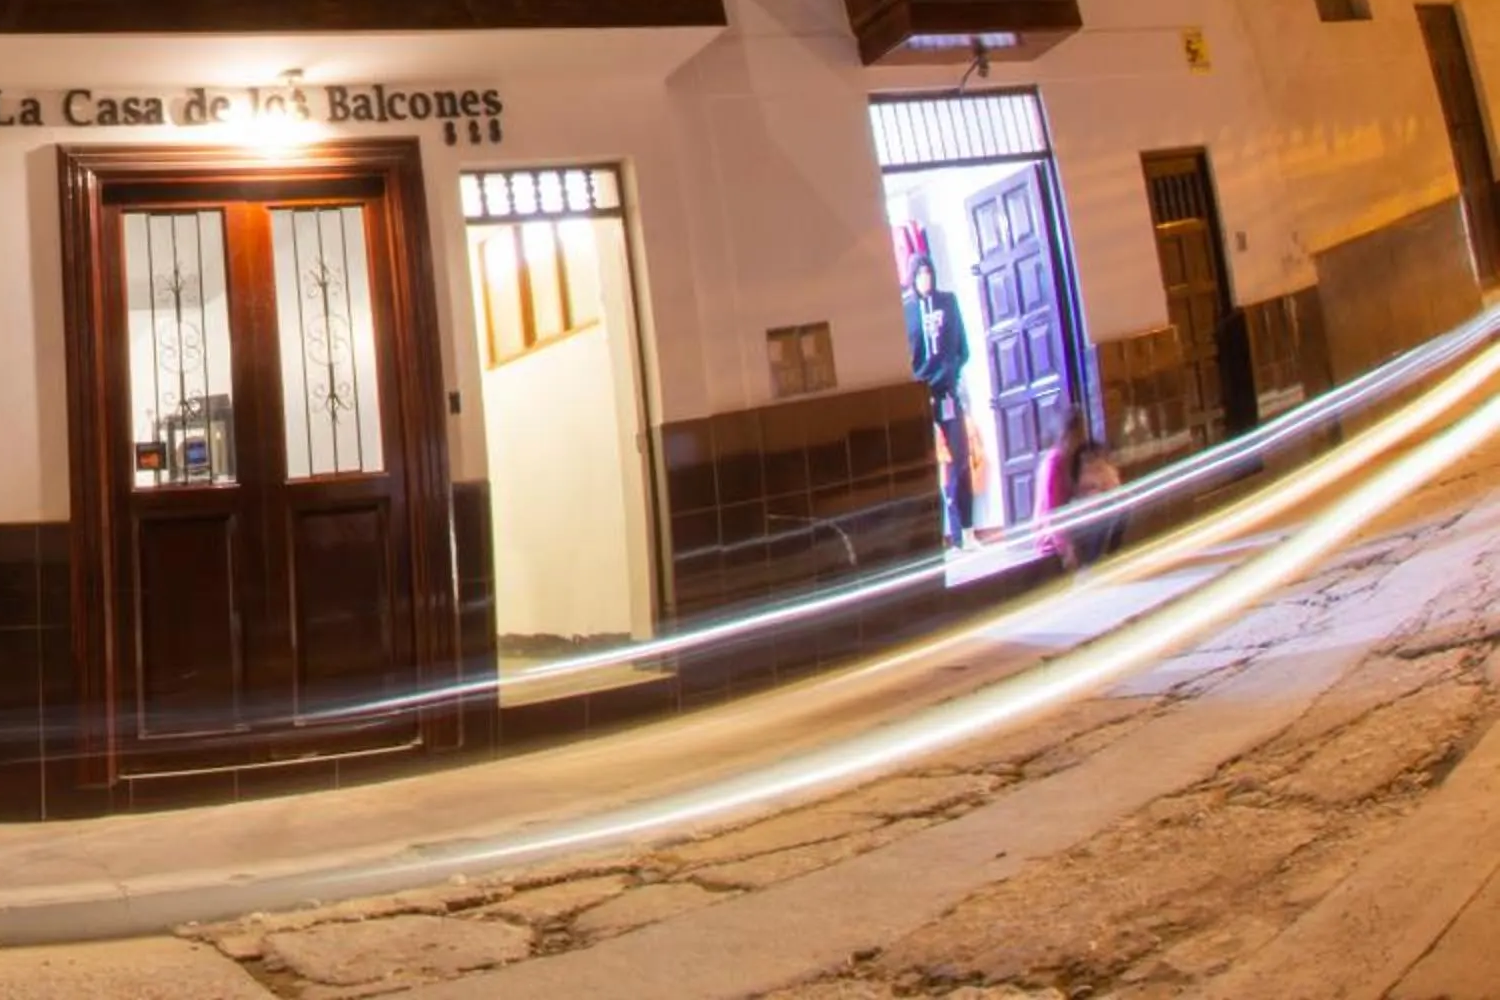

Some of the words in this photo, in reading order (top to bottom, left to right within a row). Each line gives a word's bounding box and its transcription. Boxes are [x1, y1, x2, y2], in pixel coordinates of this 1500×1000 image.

[62, 90, 164, 127] Casa
[184, 87, 231, 124] de
[325, 84, 503, 123] Balcones
